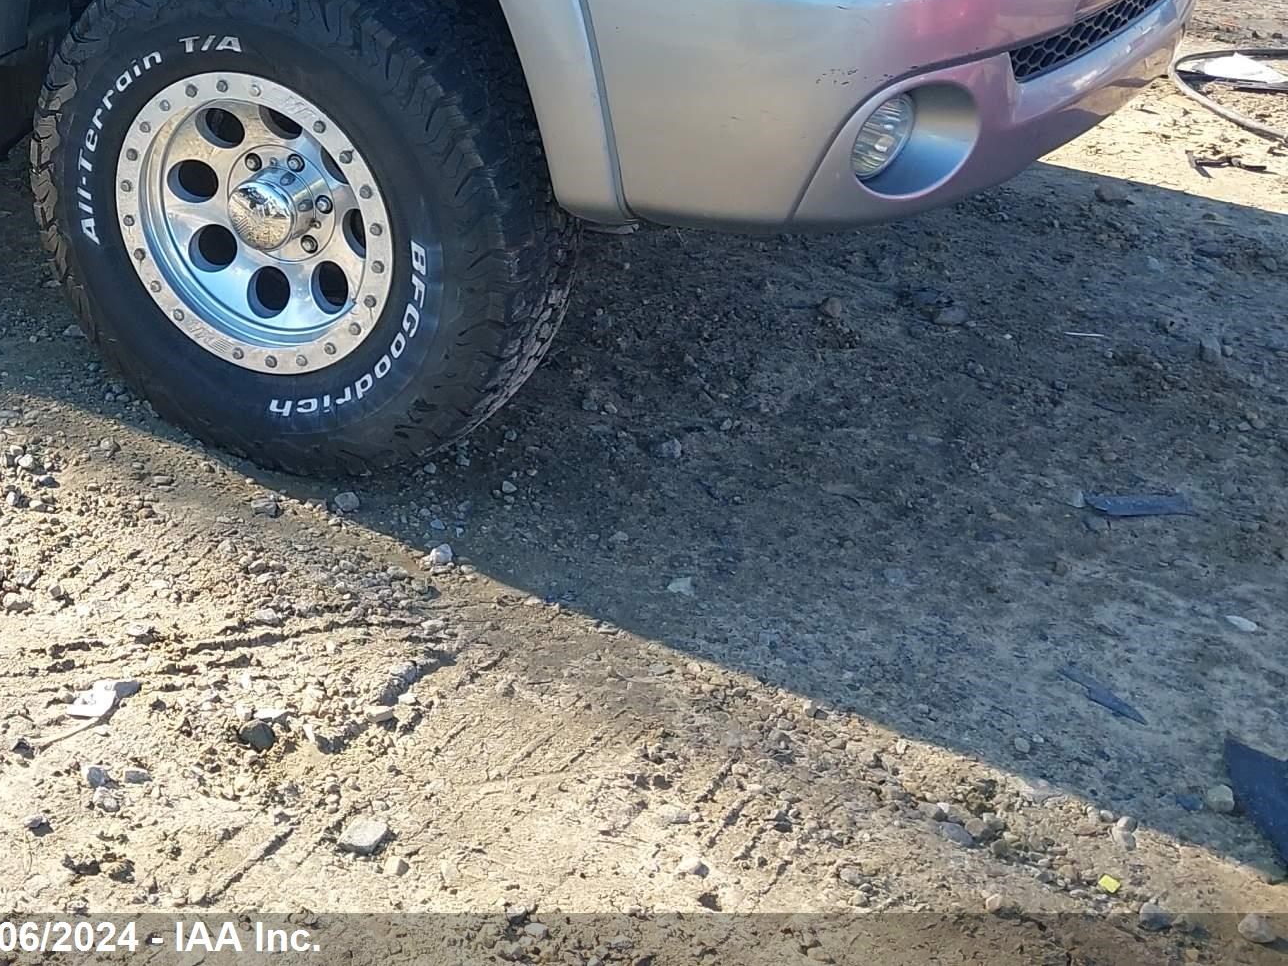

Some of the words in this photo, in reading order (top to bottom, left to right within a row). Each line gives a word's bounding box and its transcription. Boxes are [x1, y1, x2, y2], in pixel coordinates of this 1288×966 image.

[76, 50, 163, 246] All-Terrain
[178, 34, 243, 53] T/A
[268, 239, 427, 417] BFGoodrich
